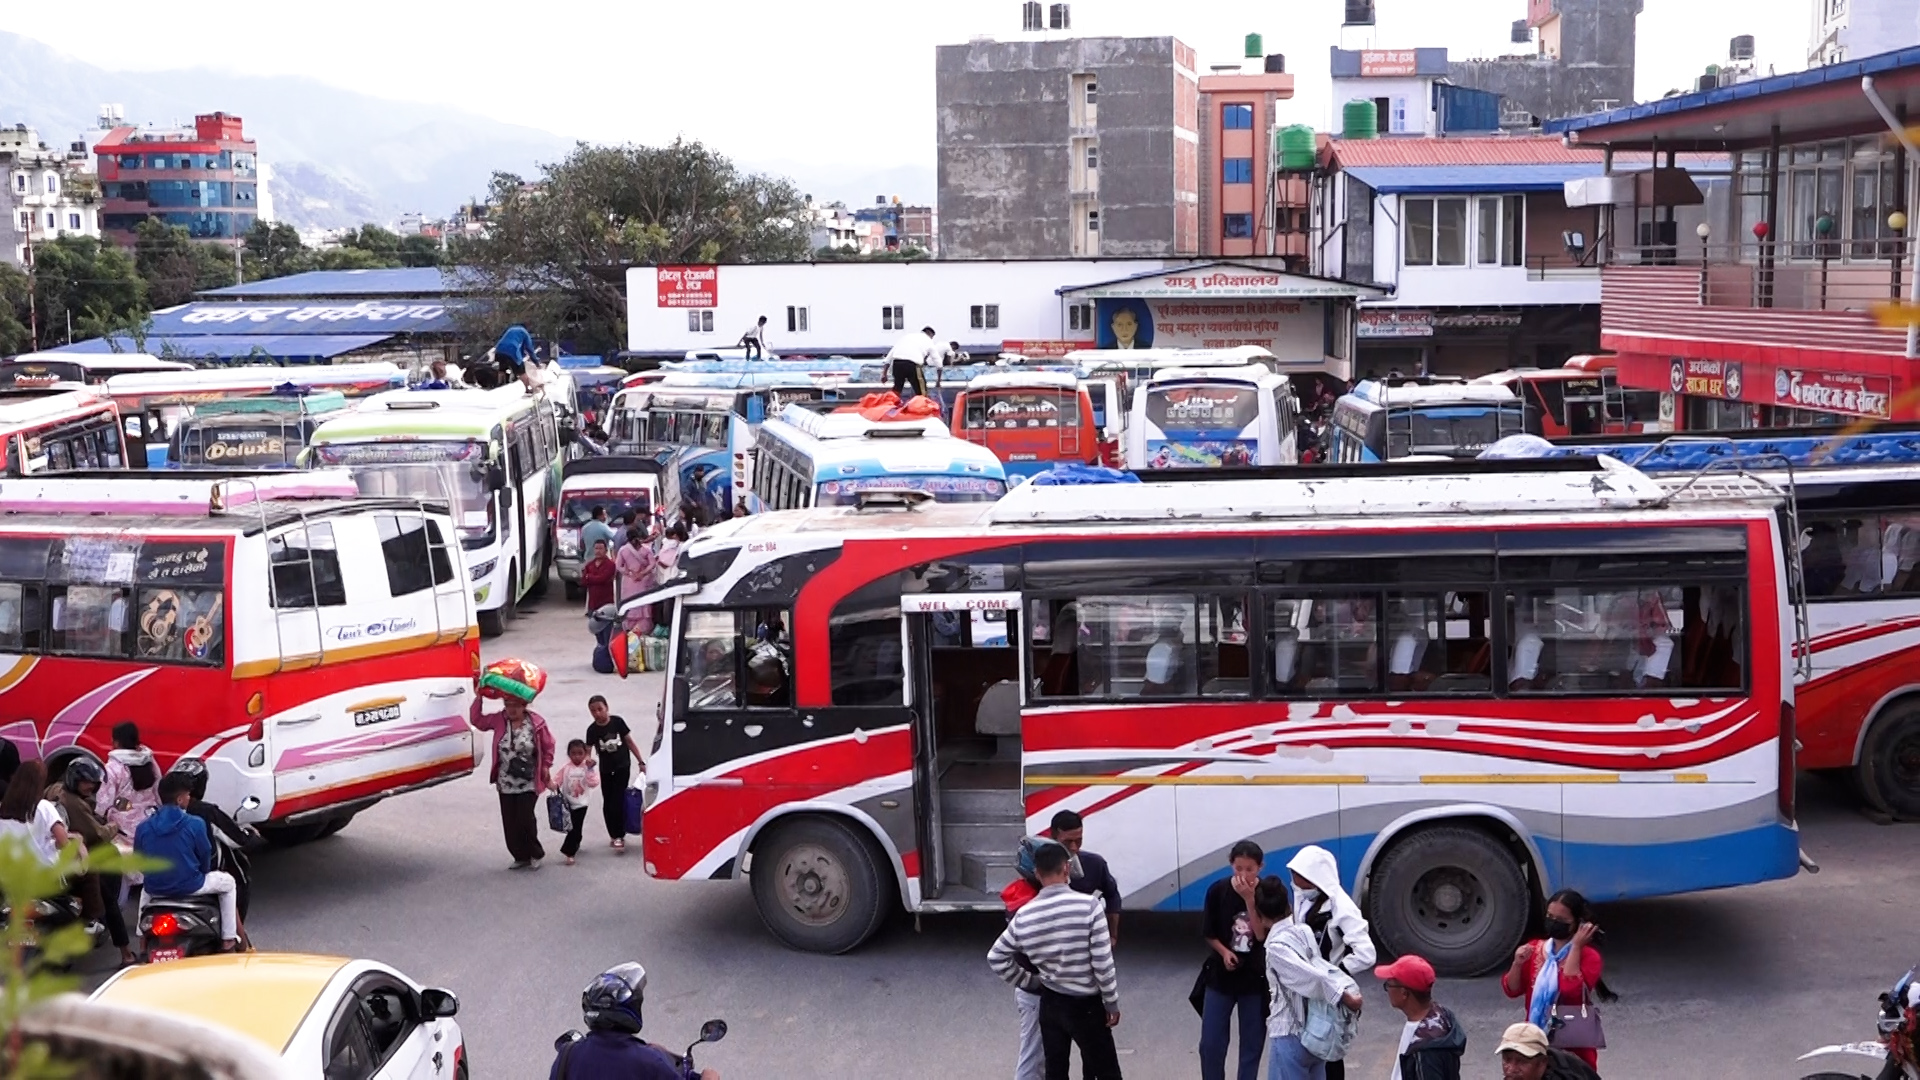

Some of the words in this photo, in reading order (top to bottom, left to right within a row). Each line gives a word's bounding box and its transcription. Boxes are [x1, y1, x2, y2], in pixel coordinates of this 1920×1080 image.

[1202, 273, 1280, 287] प्रतिक्षालय
[1686, 377, 1708, 393] खाजा
[1710, 379, 1724, 396] घर
[919, 601, 949, 611] WEL
[966, 599, 1009, 611] COME
